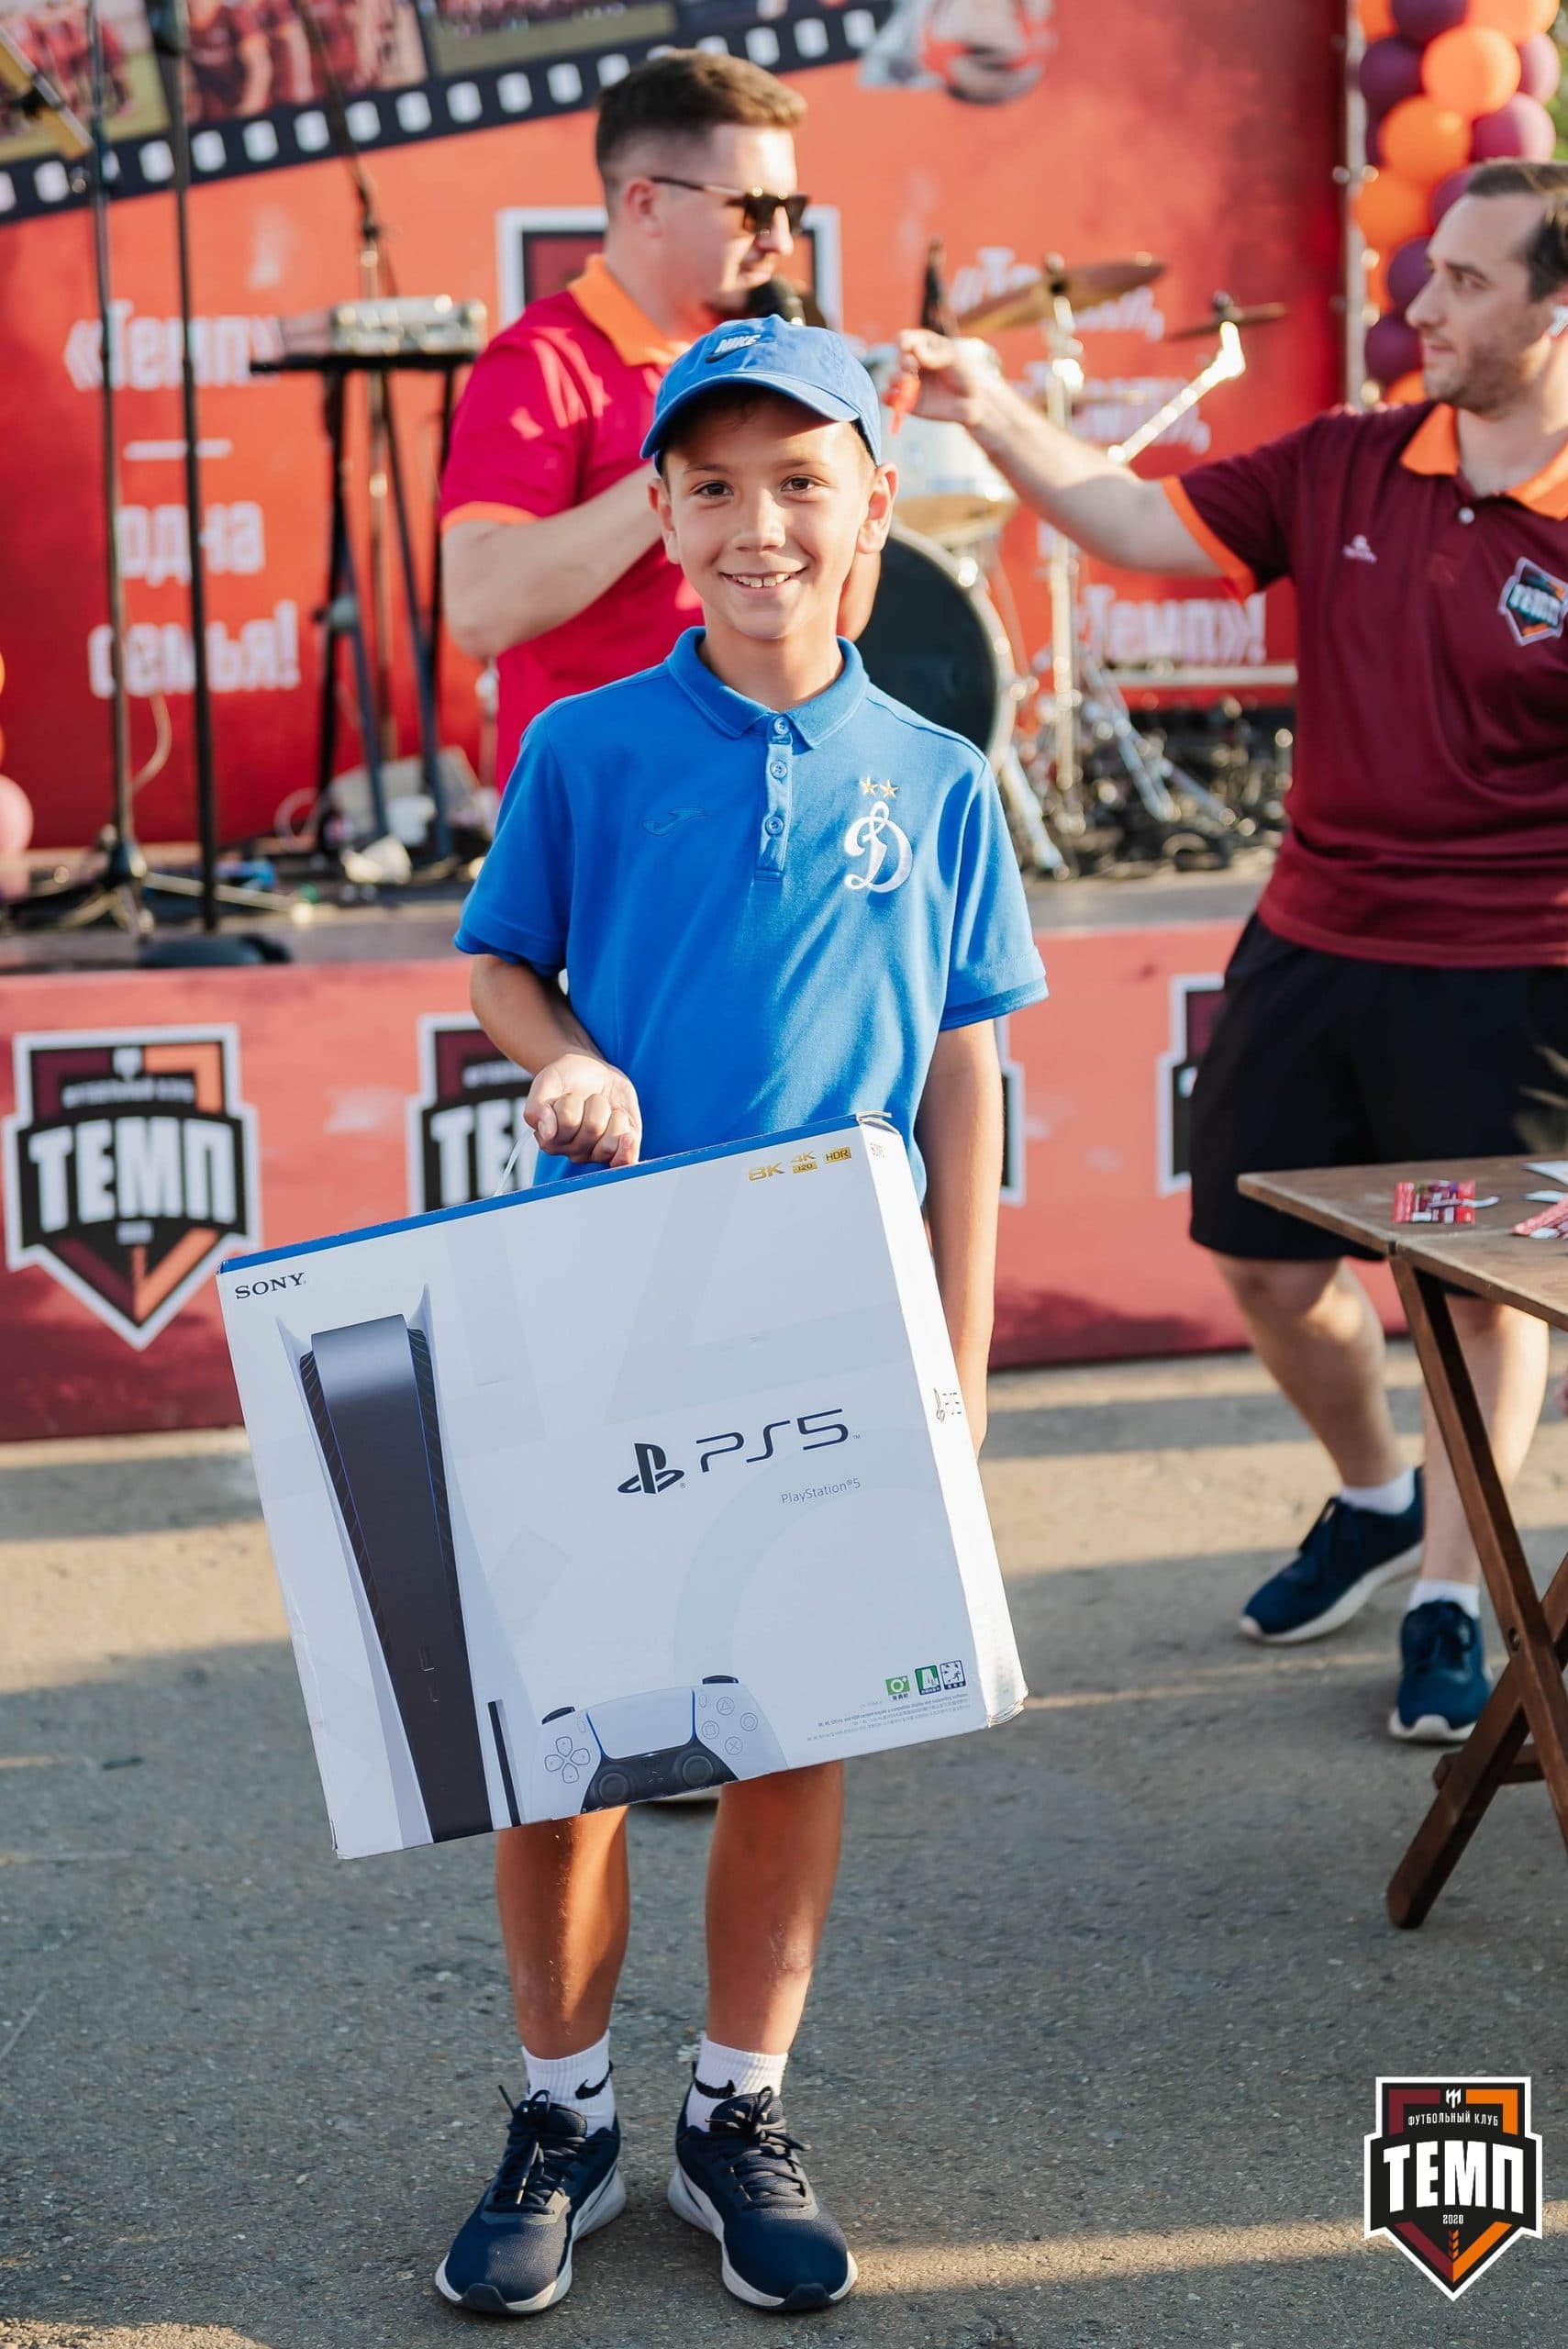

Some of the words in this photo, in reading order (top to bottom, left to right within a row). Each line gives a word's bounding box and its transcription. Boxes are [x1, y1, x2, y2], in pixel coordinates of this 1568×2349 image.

[714, 334, 762, 353] NIKE
[790, 1151, 816, 1163] 4K
[28, 1115, 236, 1233] ТЕМП
[748, 1162, 785, 1182] 8K
[234, 1272, 306, 1299] SONY
